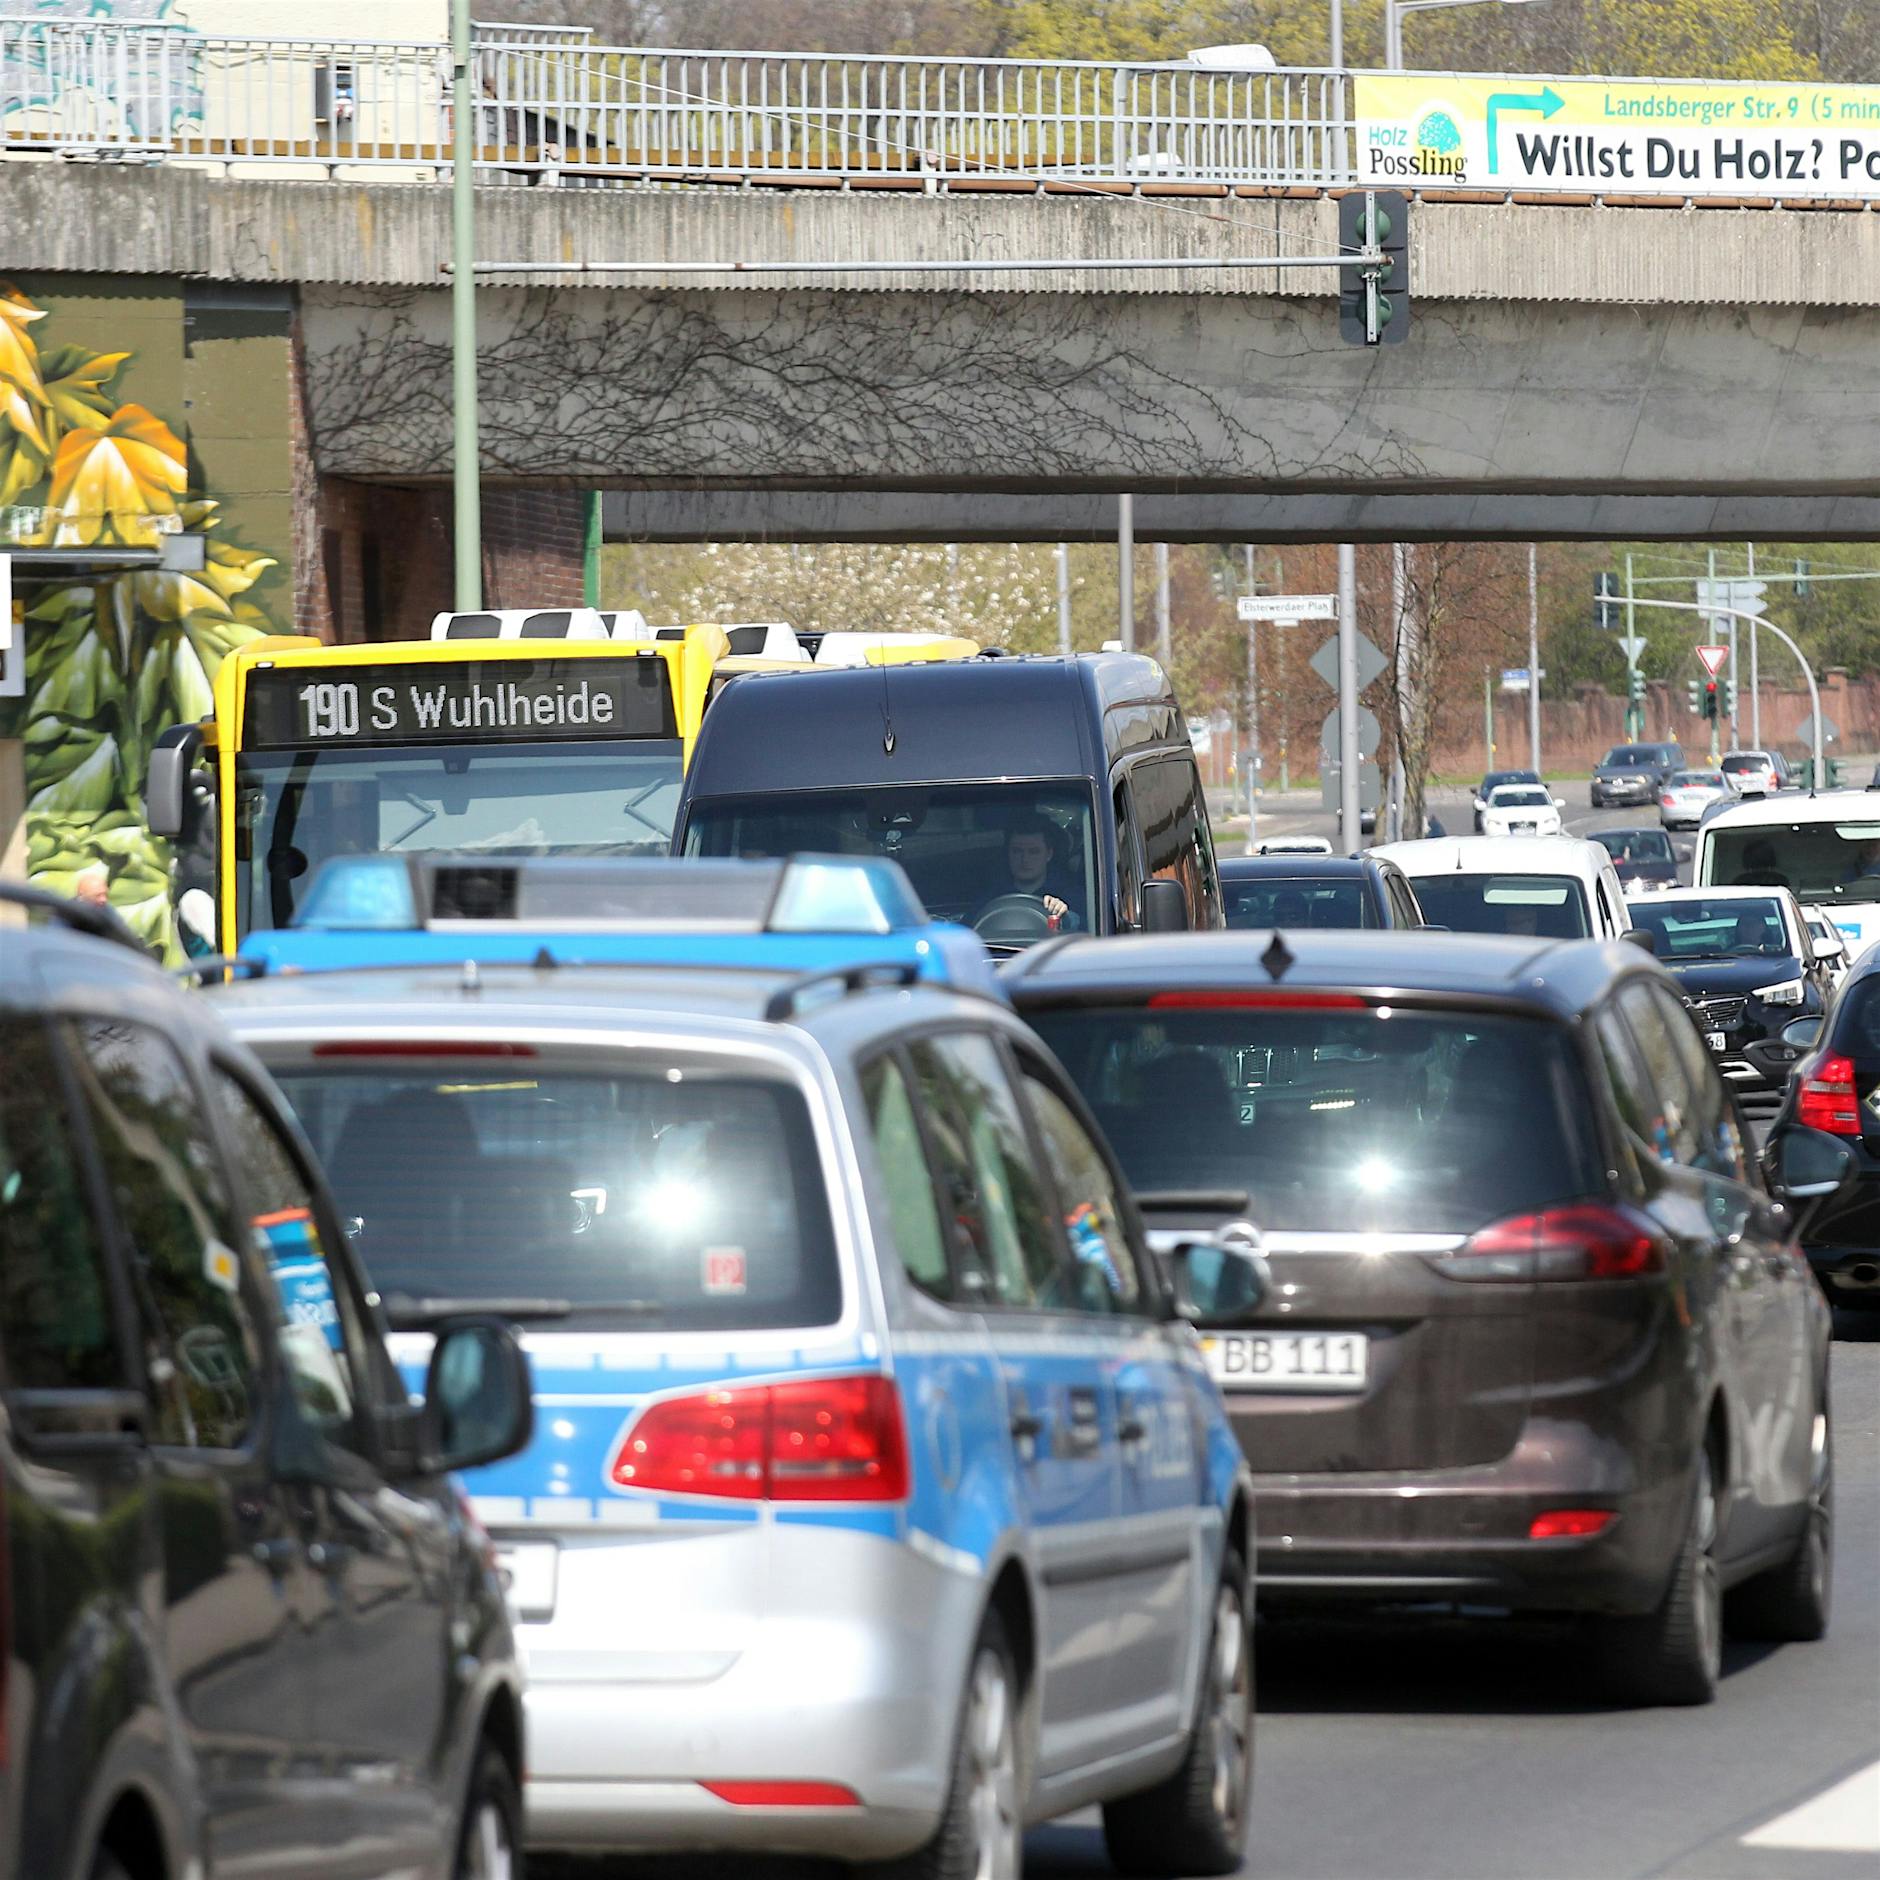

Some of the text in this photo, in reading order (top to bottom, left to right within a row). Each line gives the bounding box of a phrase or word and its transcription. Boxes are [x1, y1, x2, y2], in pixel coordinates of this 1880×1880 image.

[1604, 94, 1736, 125] Landsberger
[1743, 96, 1781, 118] Str.
[1787, 96, 1799, 118] 9
[1811, 92, 1832, 122] (5
[1369, 126, 1408, 146] Holz
[1369, 147, 1467, 184] Possling
[1516, 133, 1635, 178] Willst
[1647, 137, 1701, 179] Du
[1714, 138, 1824, 180] Holz?
[1244, 602, 1305, 613] Elsterwerdaer
[300, 681, 614, 737] 190 S Wuhlheide
[1224, 1337, 1357, 1375] BB 111
